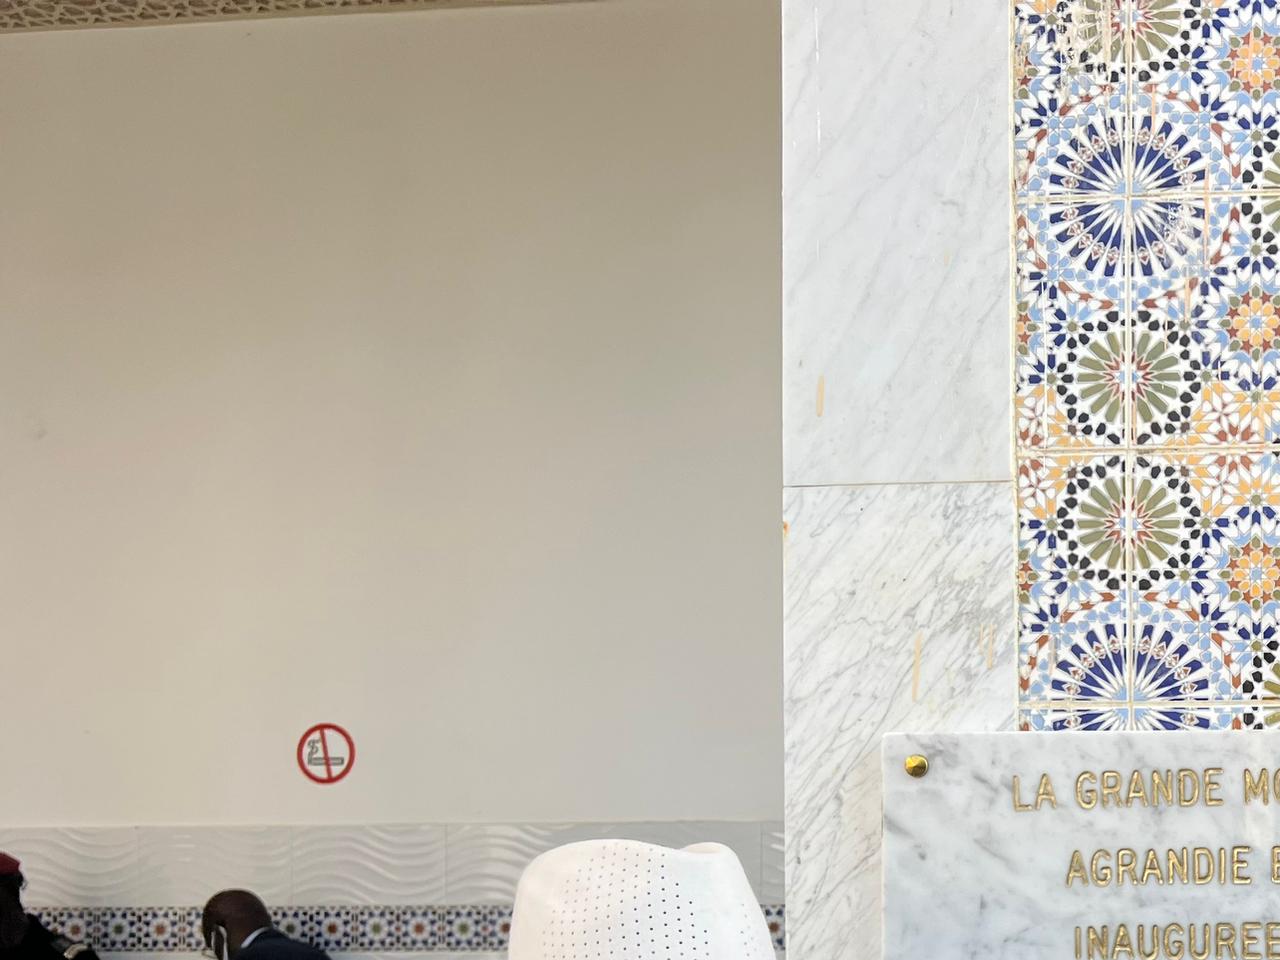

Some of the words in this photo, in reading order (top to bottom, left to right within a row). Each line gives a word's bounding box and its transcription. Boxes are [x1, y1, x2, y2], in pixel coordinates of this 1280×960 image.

[1012, 772, 1057, 812] LA
[1076, 767, 1224, 810] GRANDE
[1064, 845, 1252, 887] AGRANDIE
